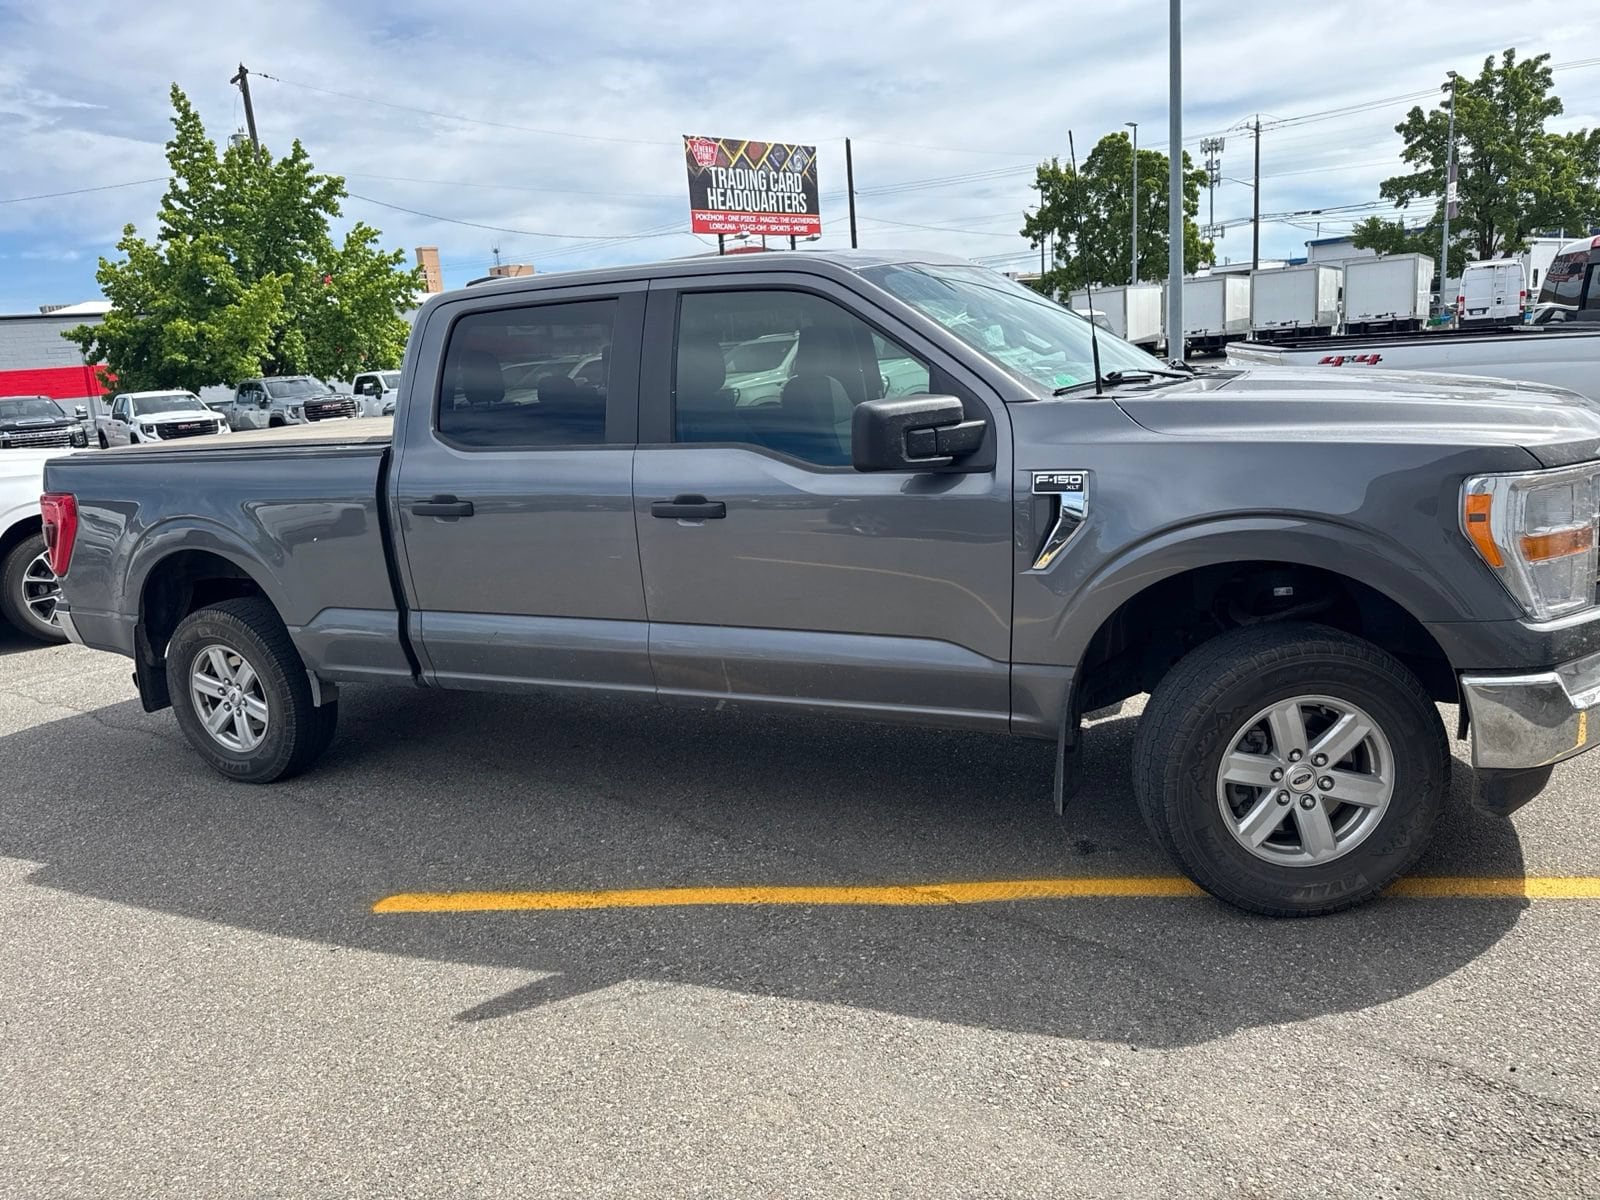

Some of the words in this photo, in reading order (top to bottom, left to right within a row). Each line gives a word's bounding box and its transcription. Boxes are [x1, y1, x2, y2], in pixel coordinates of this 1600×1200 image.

[709, 167, 767, 191] TRADING
[769, 171, 803, 193] CARD
[707, 187, 807, 213] HEADQUARTERS
[779, 216, 790, 224] THE
[790, 217, 820, 225] GATHERING
[709, 222, 737, 230] LORCANA
[1036, 475, 1082, 484] F-150
